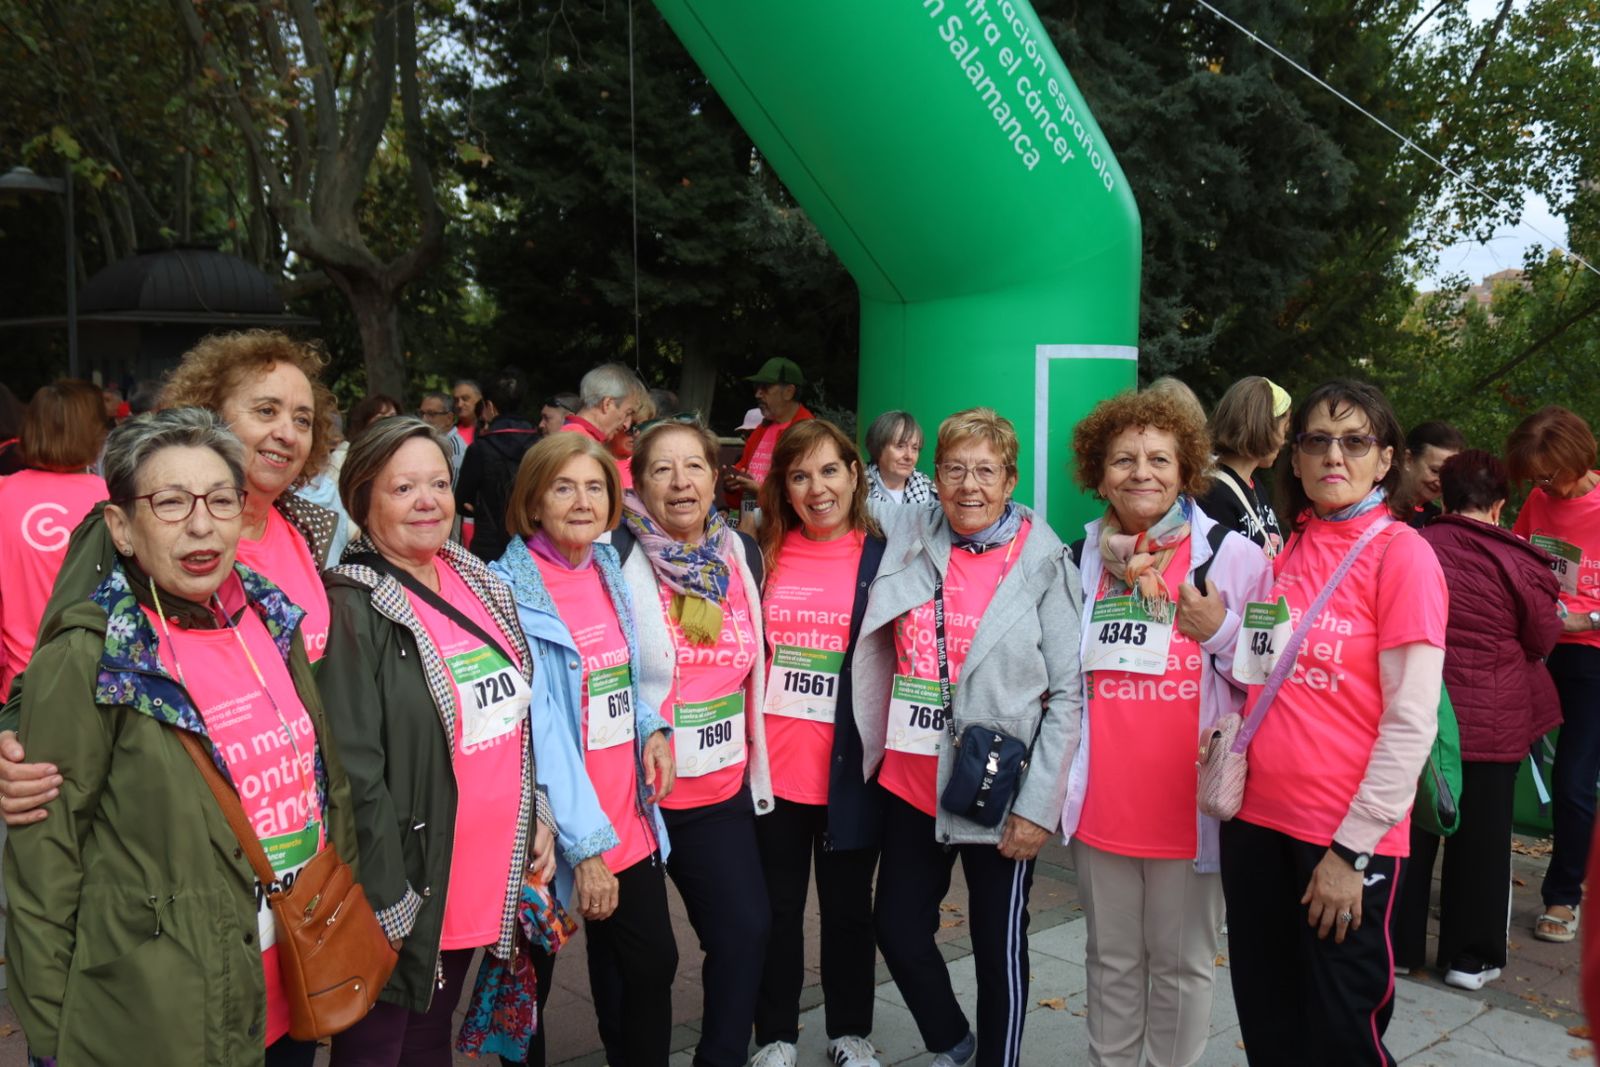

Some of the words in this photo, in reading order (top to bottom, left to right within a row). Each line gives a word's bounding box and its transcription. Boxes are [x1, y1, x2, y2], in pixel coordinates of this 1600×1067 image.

[938, 15, 1041, 172] Salamanca
[998, 47, 1022, 76] el
[1016, 76, 1075, 165] cáncer
[1048, 78, 1115, 192] española
[769, 605, 791, 623] En
[796, 609, 851, 627] marc
[934, 599, 944, 628] BIMBA
[769, 628, 844, 651] contra
[1098, 621, 1148, 646] 4343
[937, 637, 948, 668] BIMBA
[1185, 653, 1202, 671] e
[1312, 639, 1344, 665] el
[783, 670, 835, 698] 11561
[940, 677, 951, 709] BIMBA
[1098, 671, 1199, 702] cánce
[1289, 664, 1346, 693] cer
[697, 720, 732, 751] 7690
[235, 752, 312, 801] ontra
